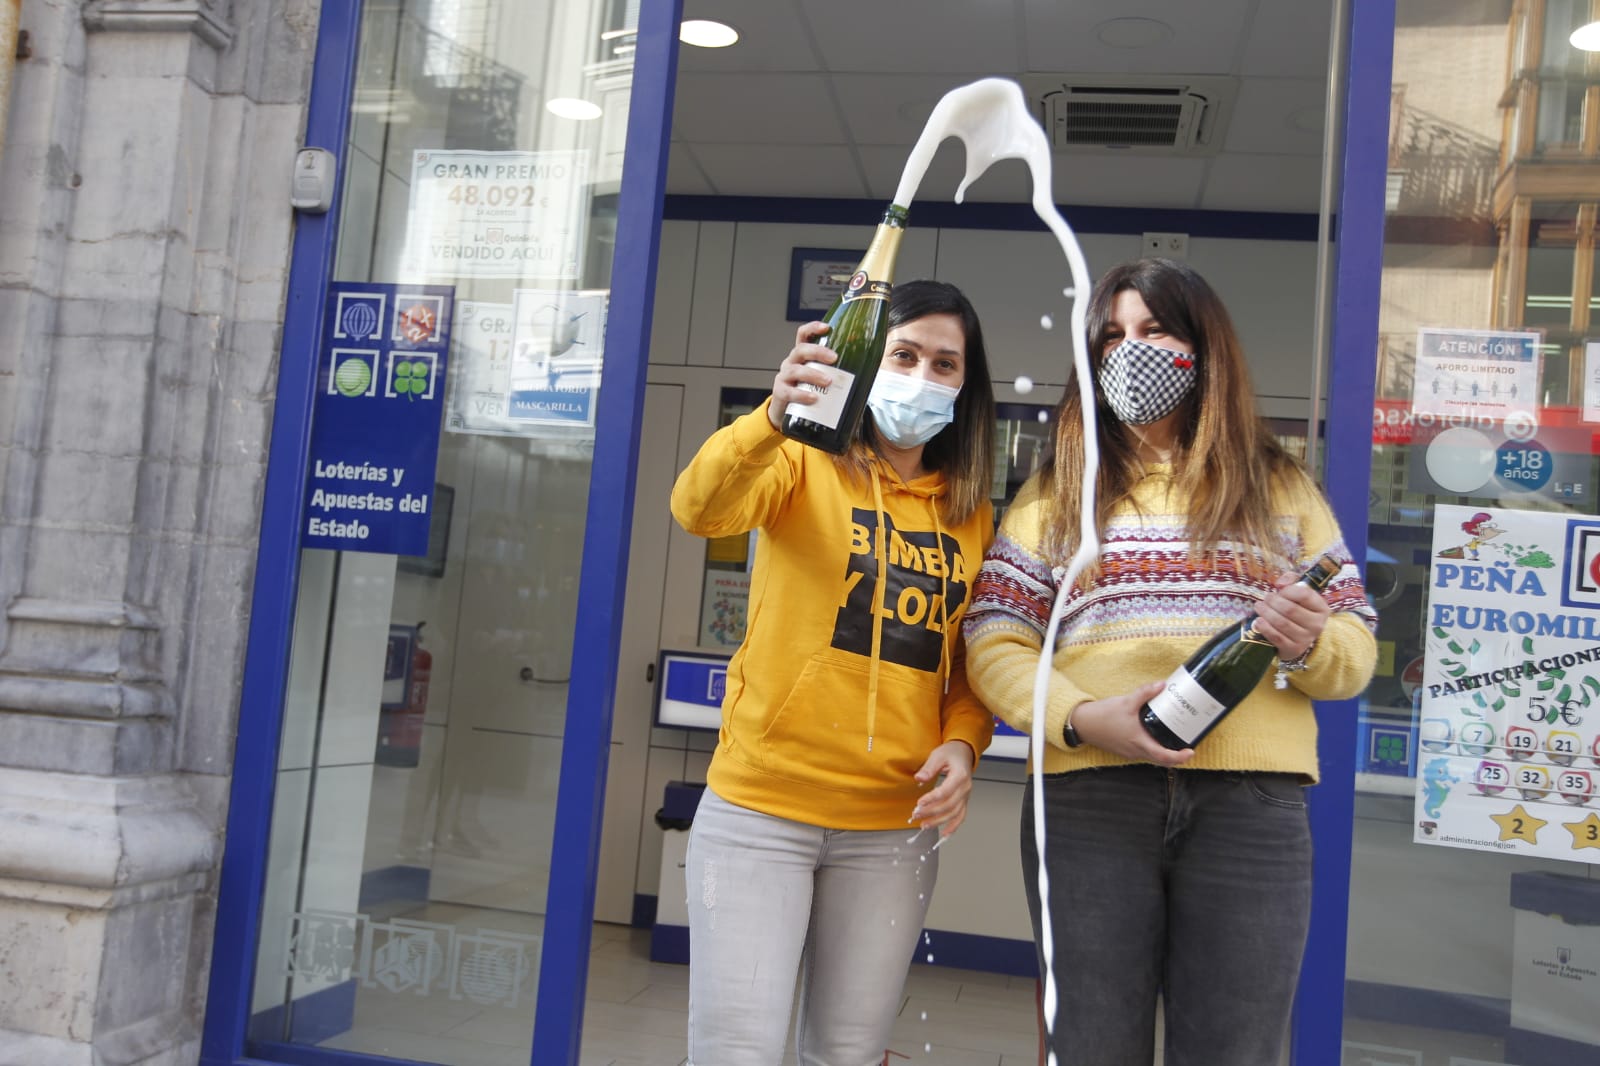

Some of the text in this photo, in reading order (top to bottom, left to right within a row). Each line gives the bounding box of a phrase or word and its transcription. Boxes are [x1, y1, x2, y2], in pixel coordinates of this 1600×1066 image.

[433, 164, 566, 180] GRAN PREMIO
[448, 184, 536, 208] 48.092
[431, 244, 504, 260] VENDIDO
[1438, 340, 1516, 356] ATENCIÓN
[1435, 363, 1516, 375] AFORO LIMITADO
[515, 400, 582, 413] MASCARILLA
[1501, 450, 1543, 470] +18
[315, 459, 405, 488] Loterías y
[1503, 467, 1540, 480] años
[310, 488, 428, 514] Apuestas del
[308, 517, 370, 539] Estado
[851, 521, 968, 584] BIMBA
[1434, 560, 1547, 597] PEÑA
[1431, 603, 1600, 642] EUROMIL
[1526, 695, 1584, 726] 5 €
[1473, 730, 1573, 752] 7 19 21
[1483, 767, 1584, 789] 25 32 35
[1511, 818, 1599, 841] 2 3
